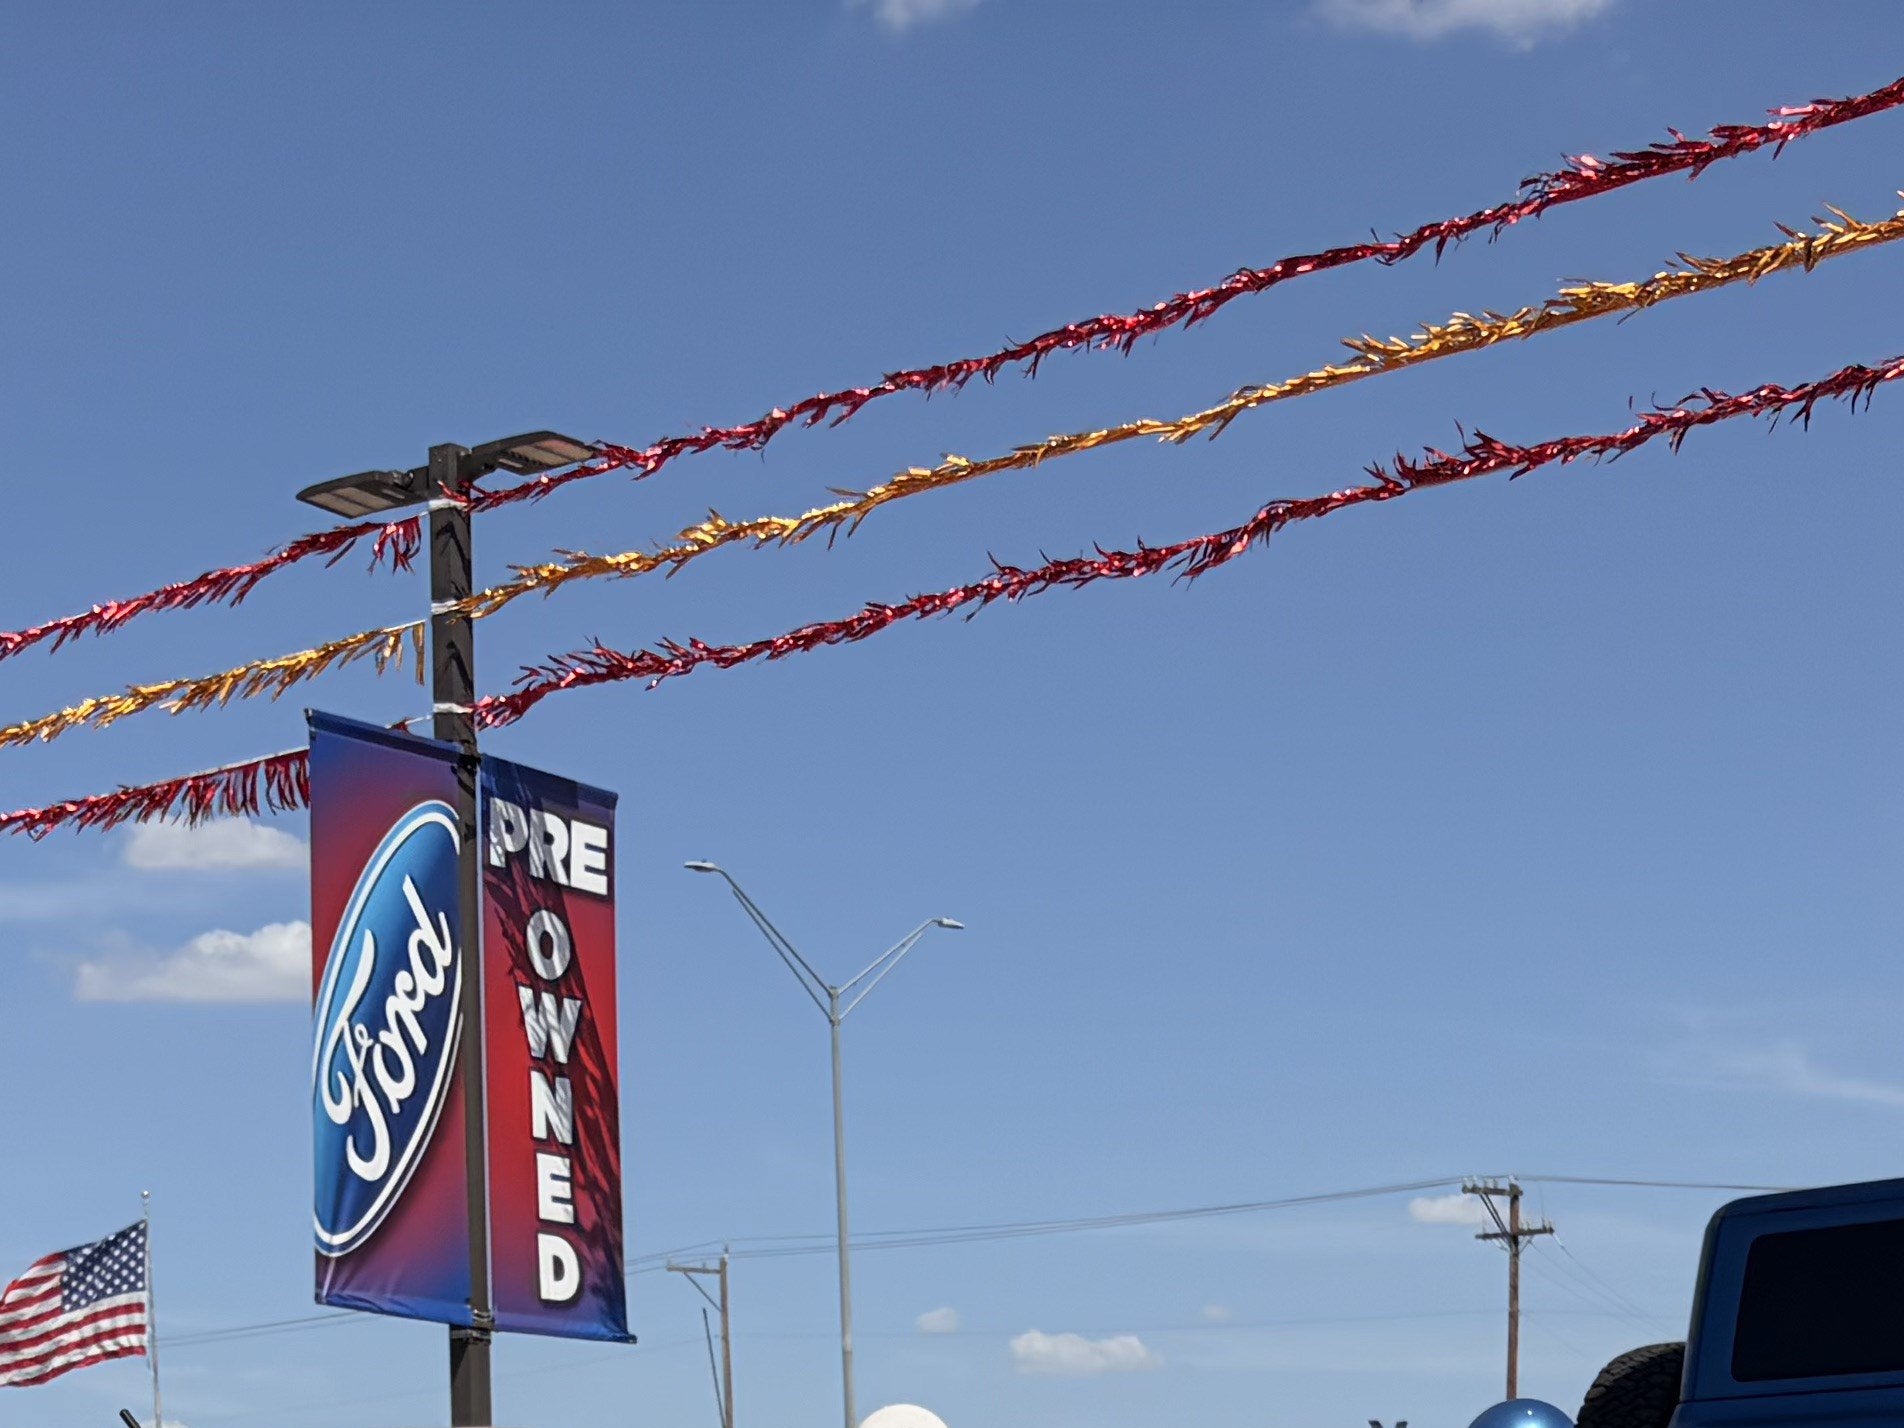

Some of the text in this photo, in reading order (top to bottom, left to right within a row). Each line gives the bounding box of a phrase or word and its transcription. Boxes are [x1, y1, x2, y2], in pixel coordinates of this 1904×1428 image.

[490, 798, 609, 896] PRE
[321, 875, 454, 1182] Ford
[519, 909, 582, 1302] OWNED
